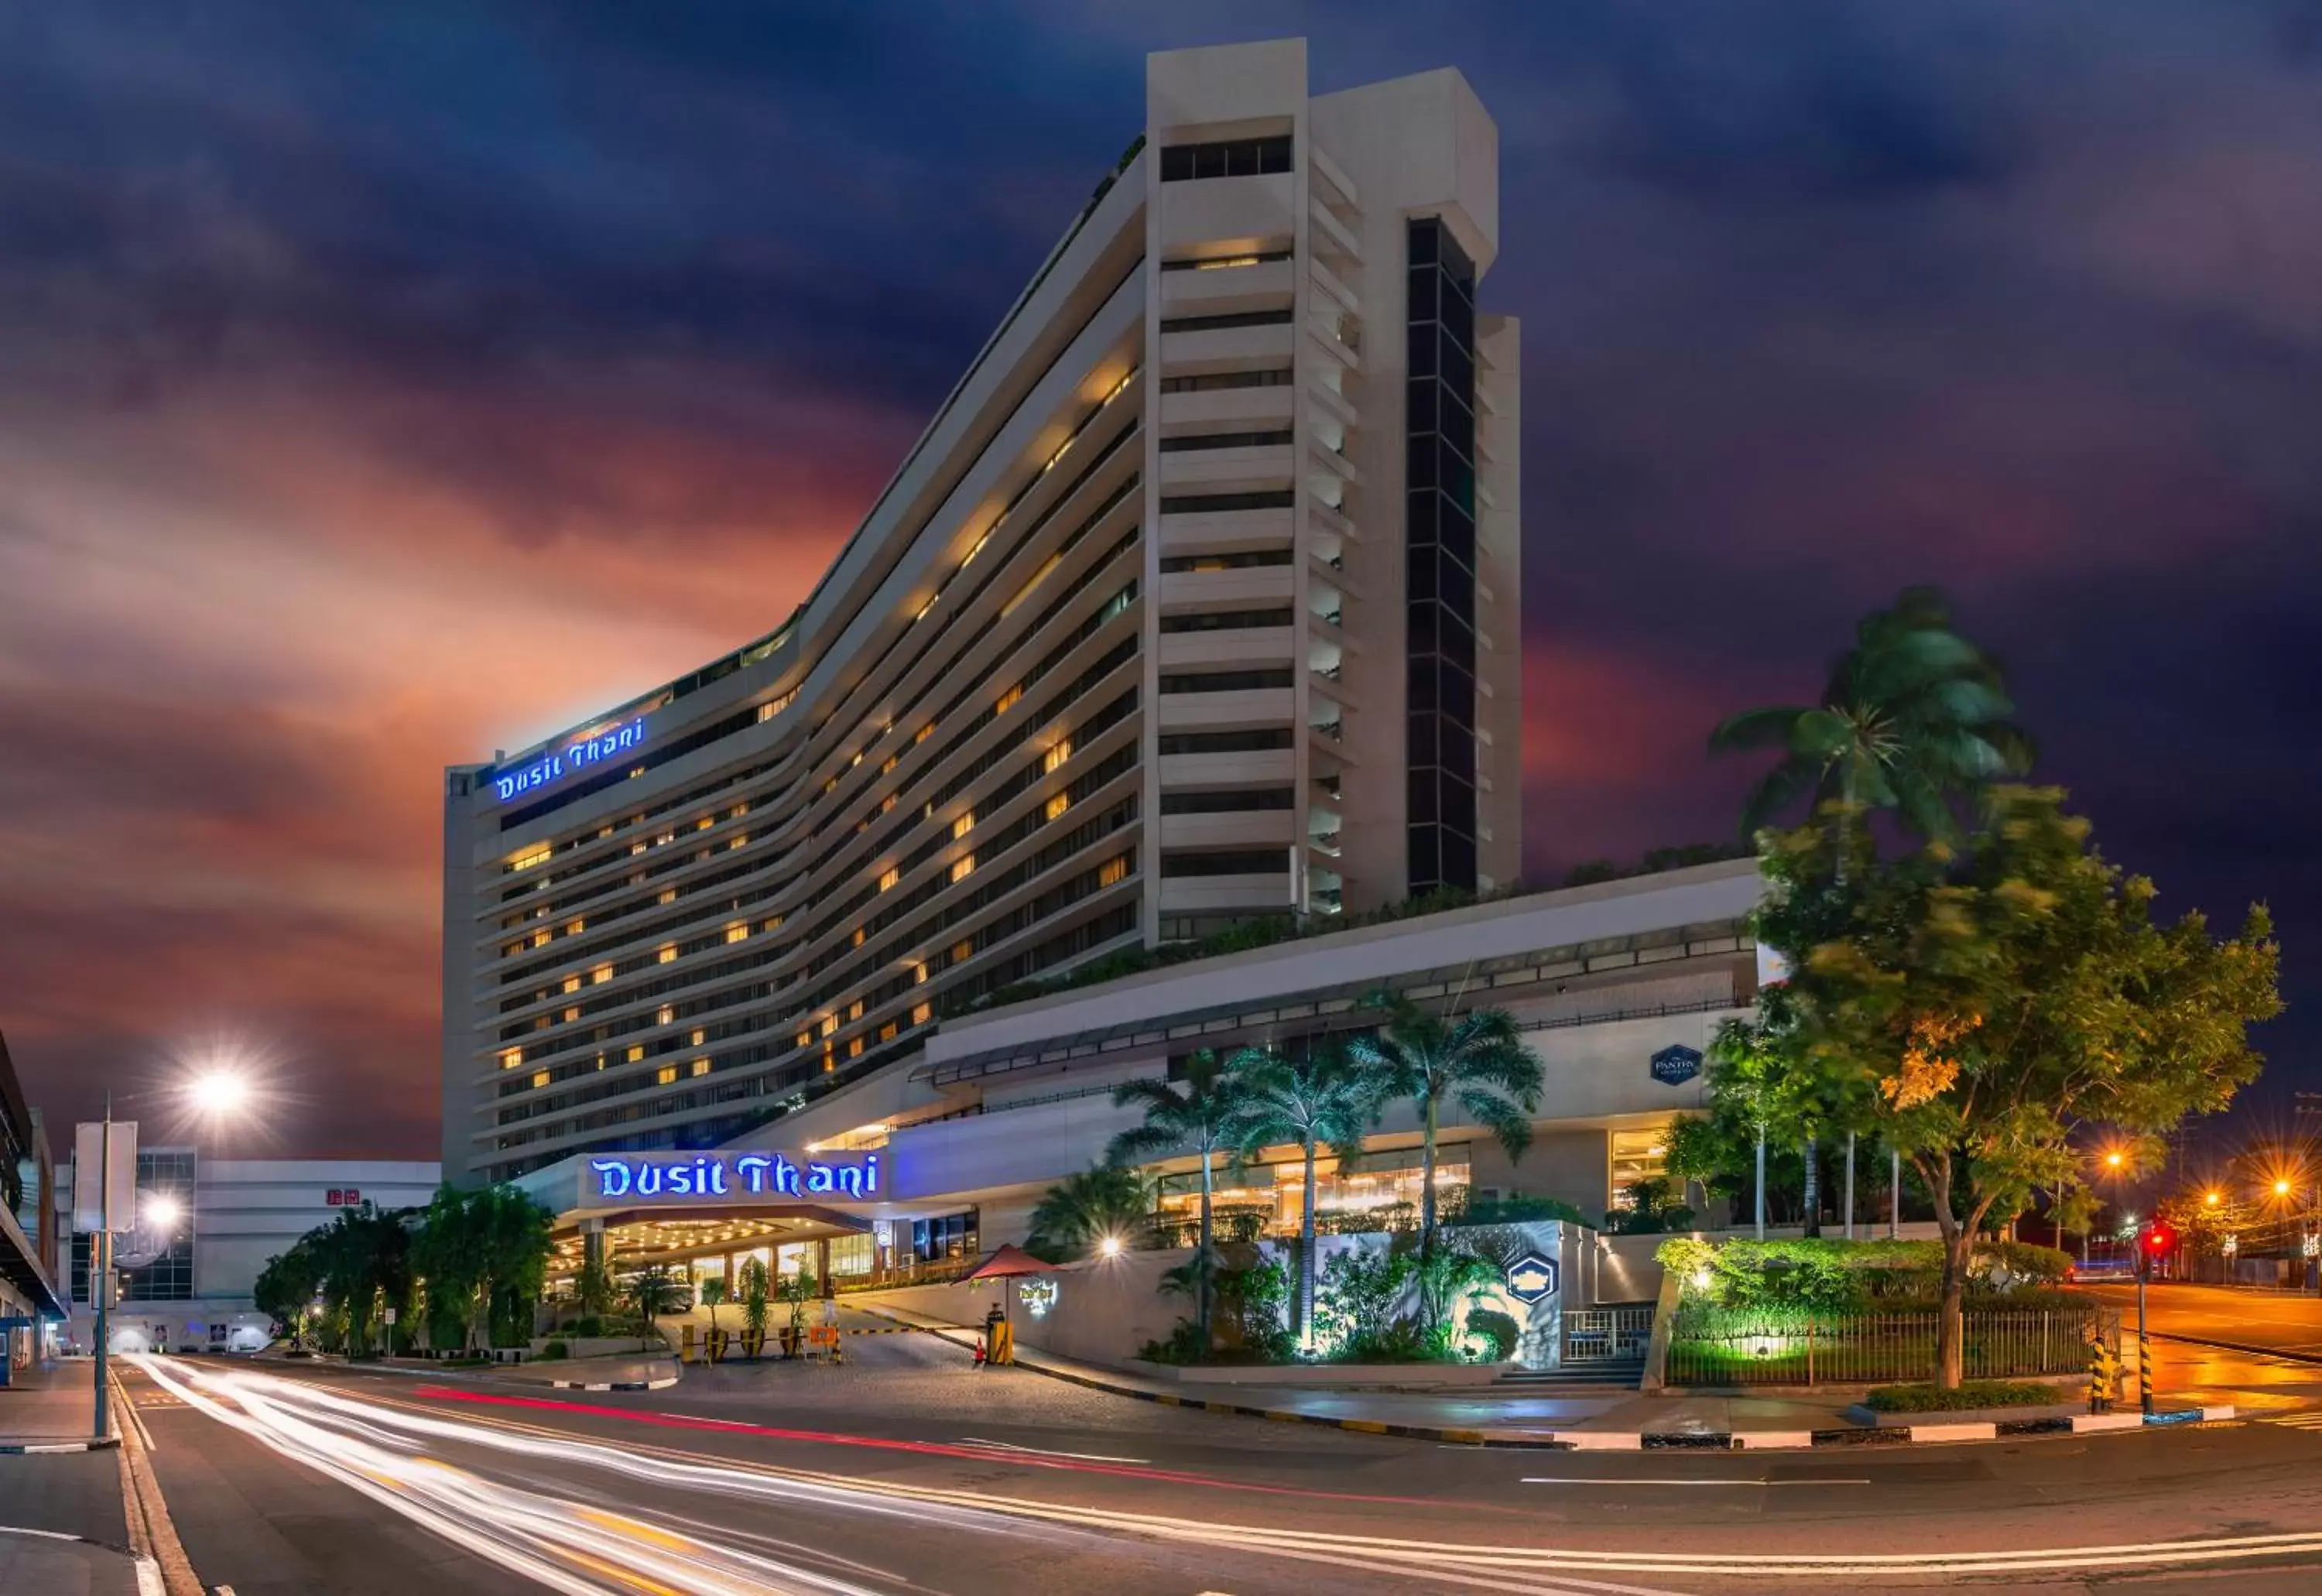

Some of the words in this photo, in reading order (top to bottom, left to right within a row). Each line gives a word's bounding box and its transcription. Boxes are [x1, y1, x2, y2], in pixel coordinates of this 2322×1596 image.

[496, 755, 562, 800] Dusit
[569, 718, 642, 766] Thani
[592, 1158, 728, 1196] Dusit
[738, 1153, 876, 1199] Thani
